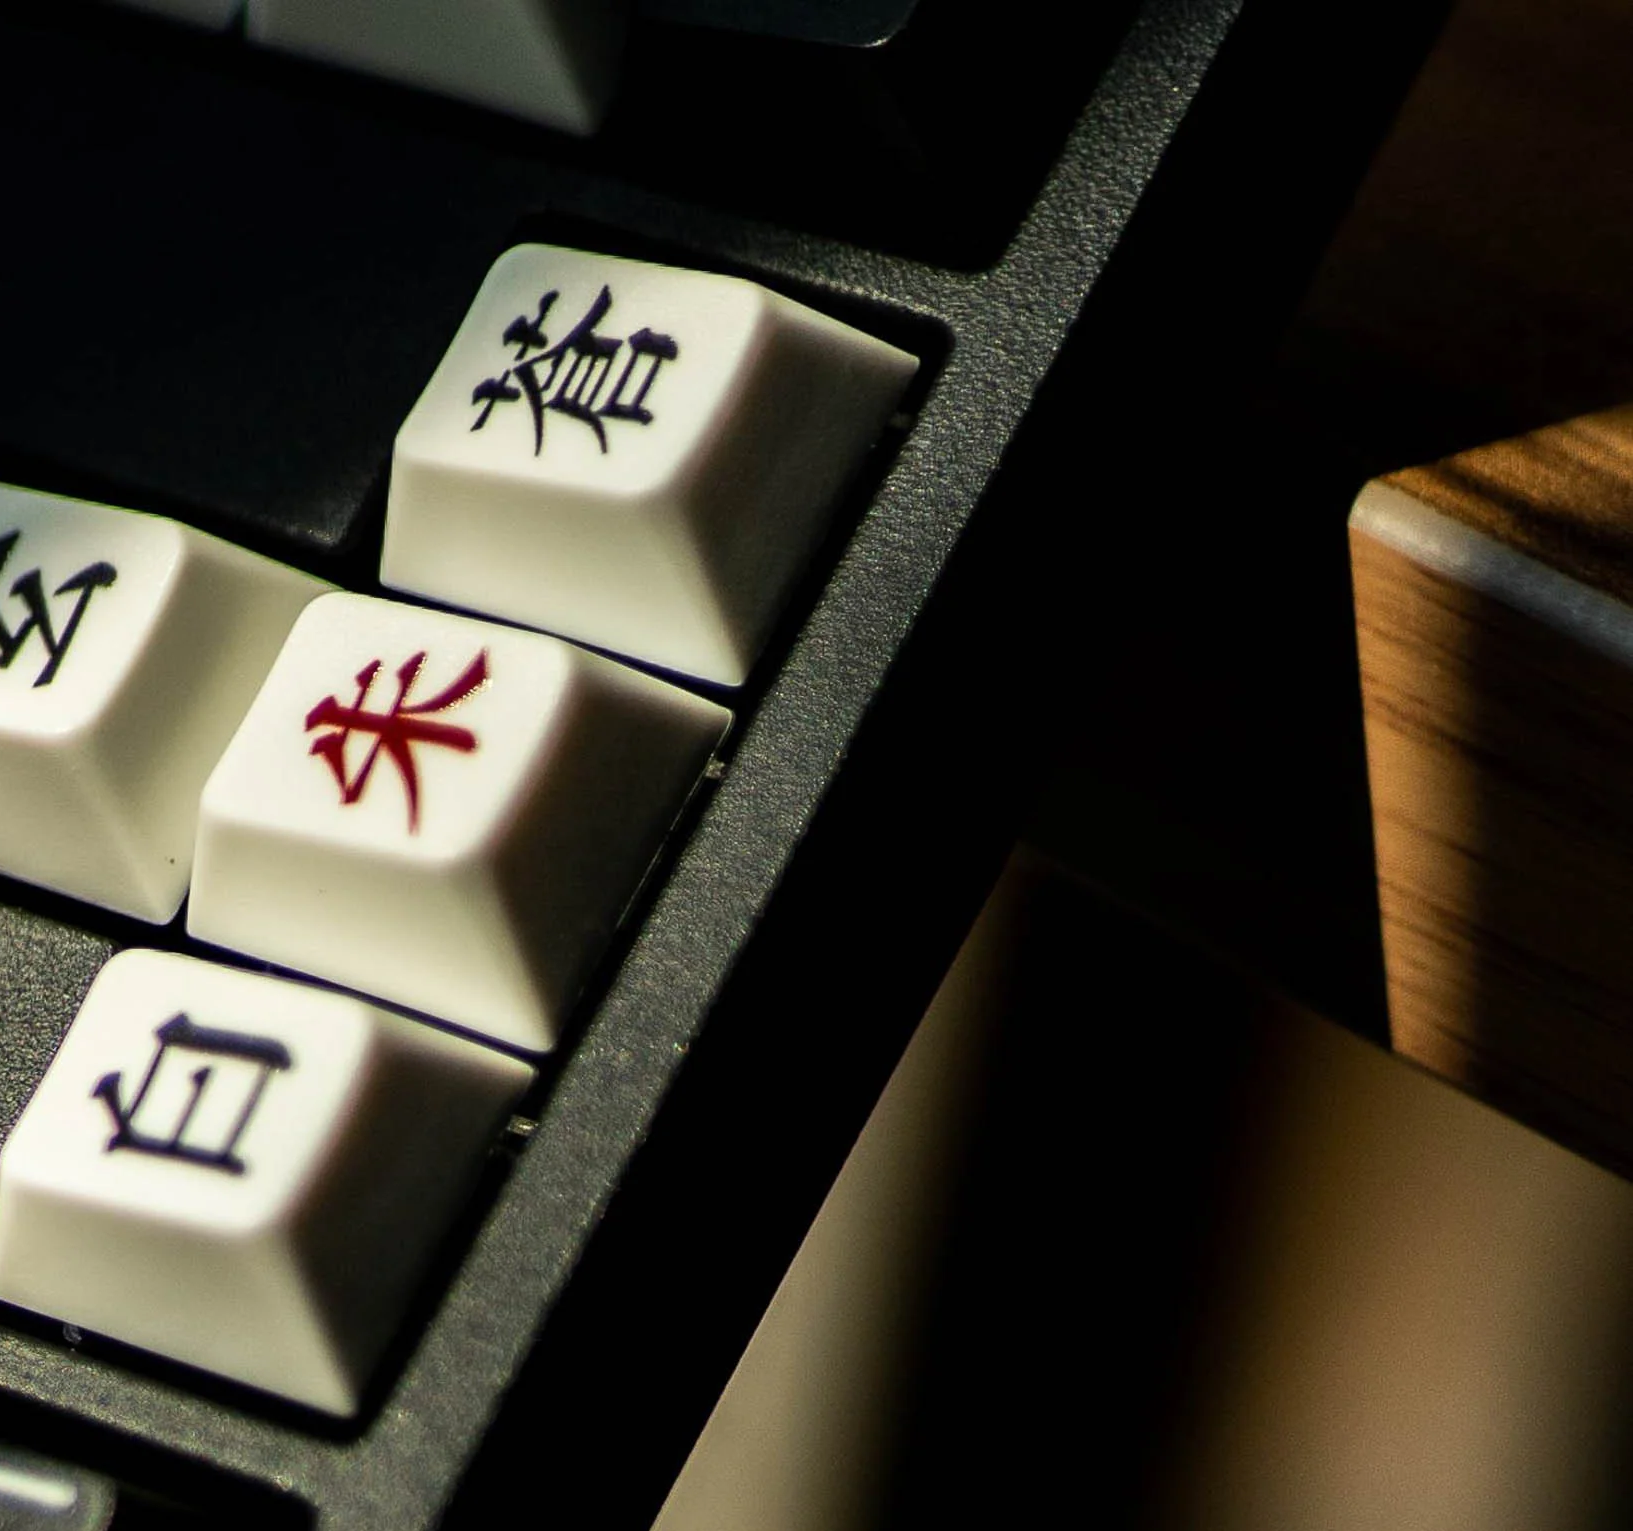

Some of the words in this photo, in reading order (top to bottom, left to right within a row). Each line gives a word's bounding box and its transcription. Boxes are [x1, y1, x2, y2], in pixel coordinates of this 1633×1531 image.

[470, 284, 678, 456] 蒼
[305, 648, 491, 834] 朱
[96, 1016, 294, 1178] 白
